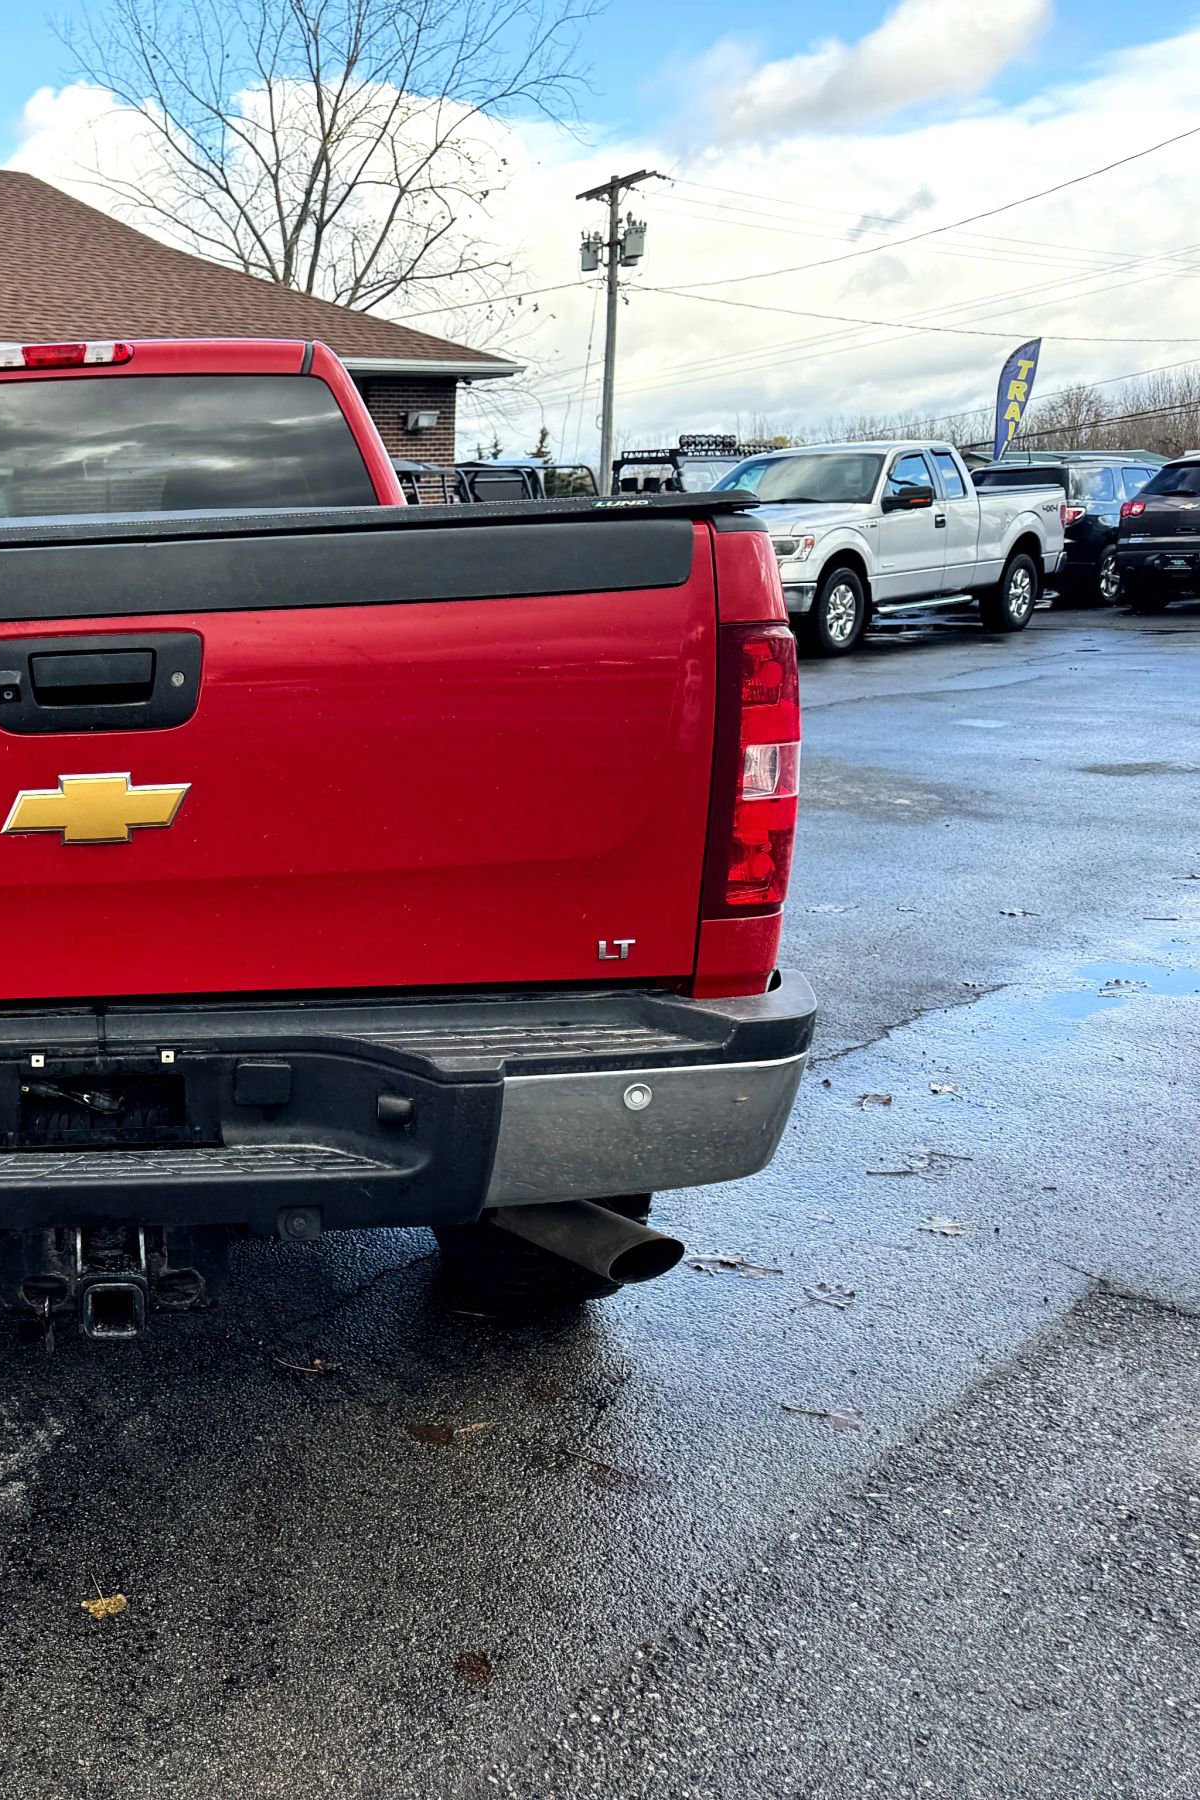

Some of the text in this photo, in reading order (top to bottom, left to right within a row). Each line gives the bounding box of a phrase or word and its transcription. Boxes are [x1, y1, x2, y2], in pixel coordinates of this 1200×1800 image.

[1003, 359, 1035, 441] TRAI
[594, 499, 649, 508] LUND
[598, 939, 636, 960] LT
